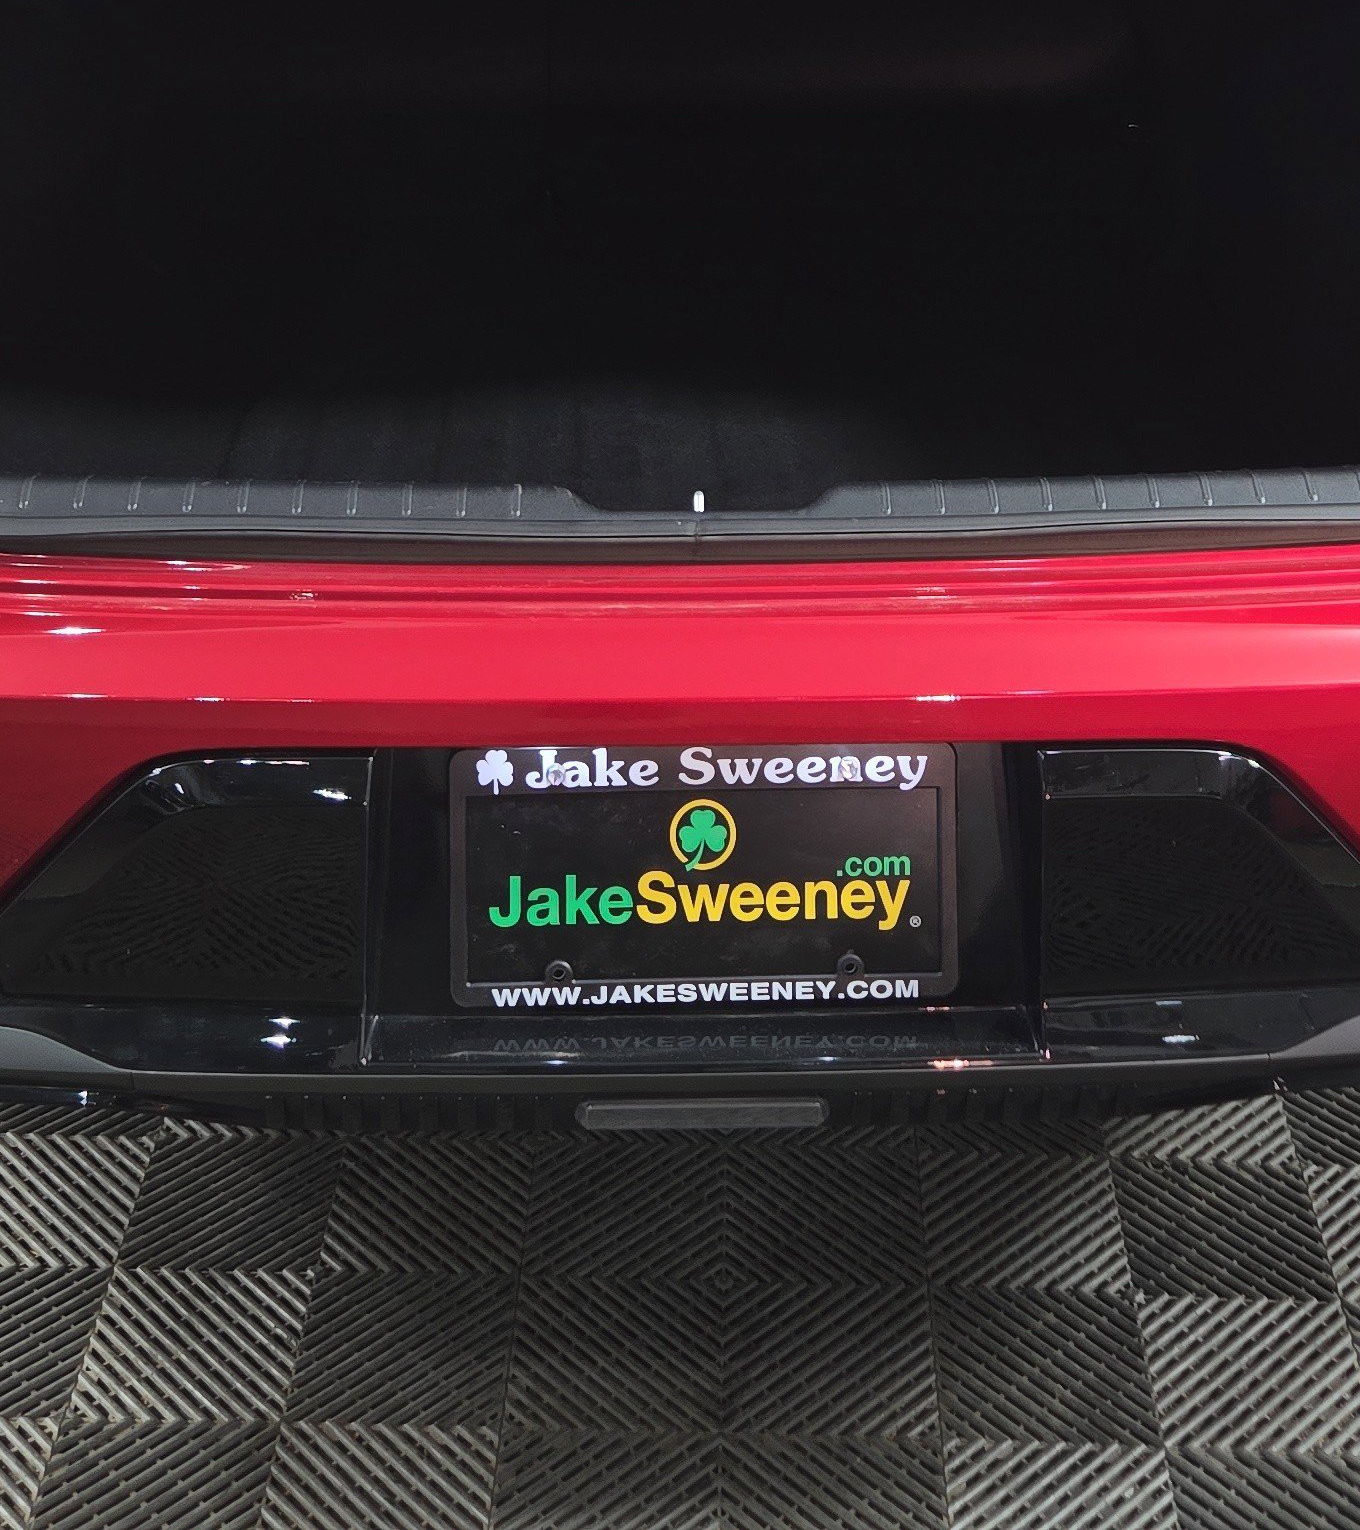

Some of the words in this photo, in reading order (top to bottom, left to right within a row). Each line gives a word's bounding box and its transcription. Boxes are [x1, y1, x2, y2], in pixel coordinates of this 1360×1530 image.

[525, 747, 661, 788] Jake
[678, 746, 928, 791] Sweeney
[836, 855, 912, 877] .com
[488, 870, 911, 931] JakeSweeney
[491, 979, 920, 1008] WWW.JAKESWEENEY.COM
